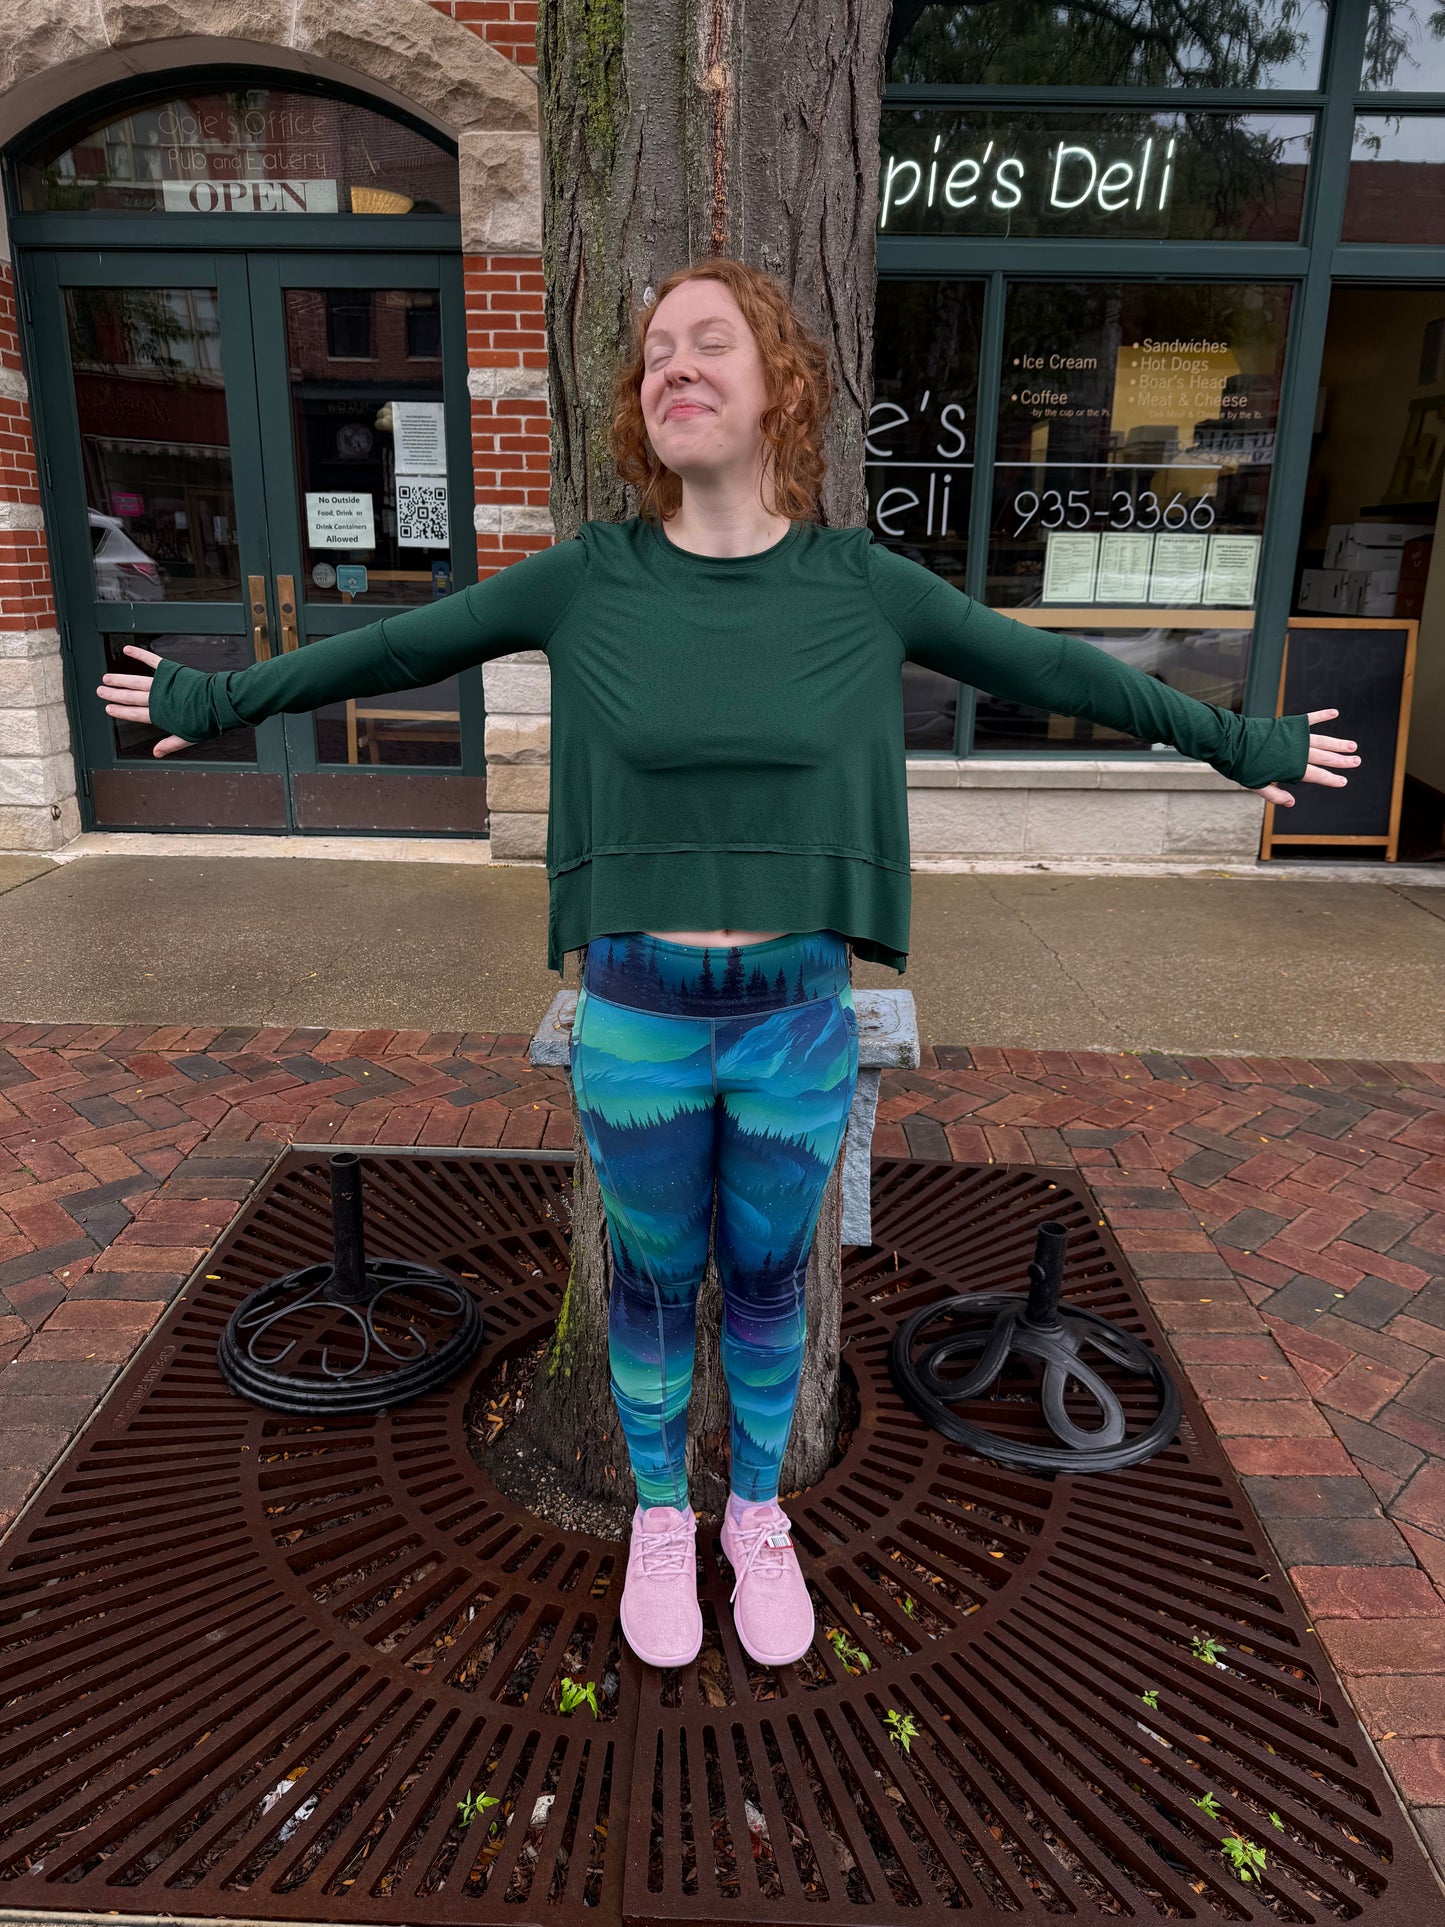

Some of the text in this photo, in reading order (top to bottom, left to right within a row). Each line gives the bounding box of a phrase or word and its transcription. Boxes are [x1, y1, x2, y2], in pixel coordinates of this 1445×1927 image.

[158, 110, 328, 145] Opie's Office
[168, 148, 327, 177] Pub and Eatery
[880, 134, 1175, 228] pie's Deli
[189, 181, 310, 212] OPEN
[1142, 338, 1228, 354] Sandwiches
[1022, 353, 1097, 369] Ice Cream
[1140, 356, 1209, 374] Hot Dogs
[1139, 374, 1228, 389] Boar's Head
[1020, 389, 1068, 405] Coffee
[1137, 391, 1248, 408] Meat & Cheese
[1044, 408, 1057, 417] the
[1059, 409, 1074, 418] cup
[1076, 409, 1085, 417] or
[1227, 411, 1238, 420] by
[1239, 411, 1251, 419] the
[865, 389, 966, 458] e's
[318, 496, 361, 504] No Outside
[875, 472, 952, 536] eli
[1013, 489, 1215, 538] 935-3366
[326, 535, 359, 543] Allowed
